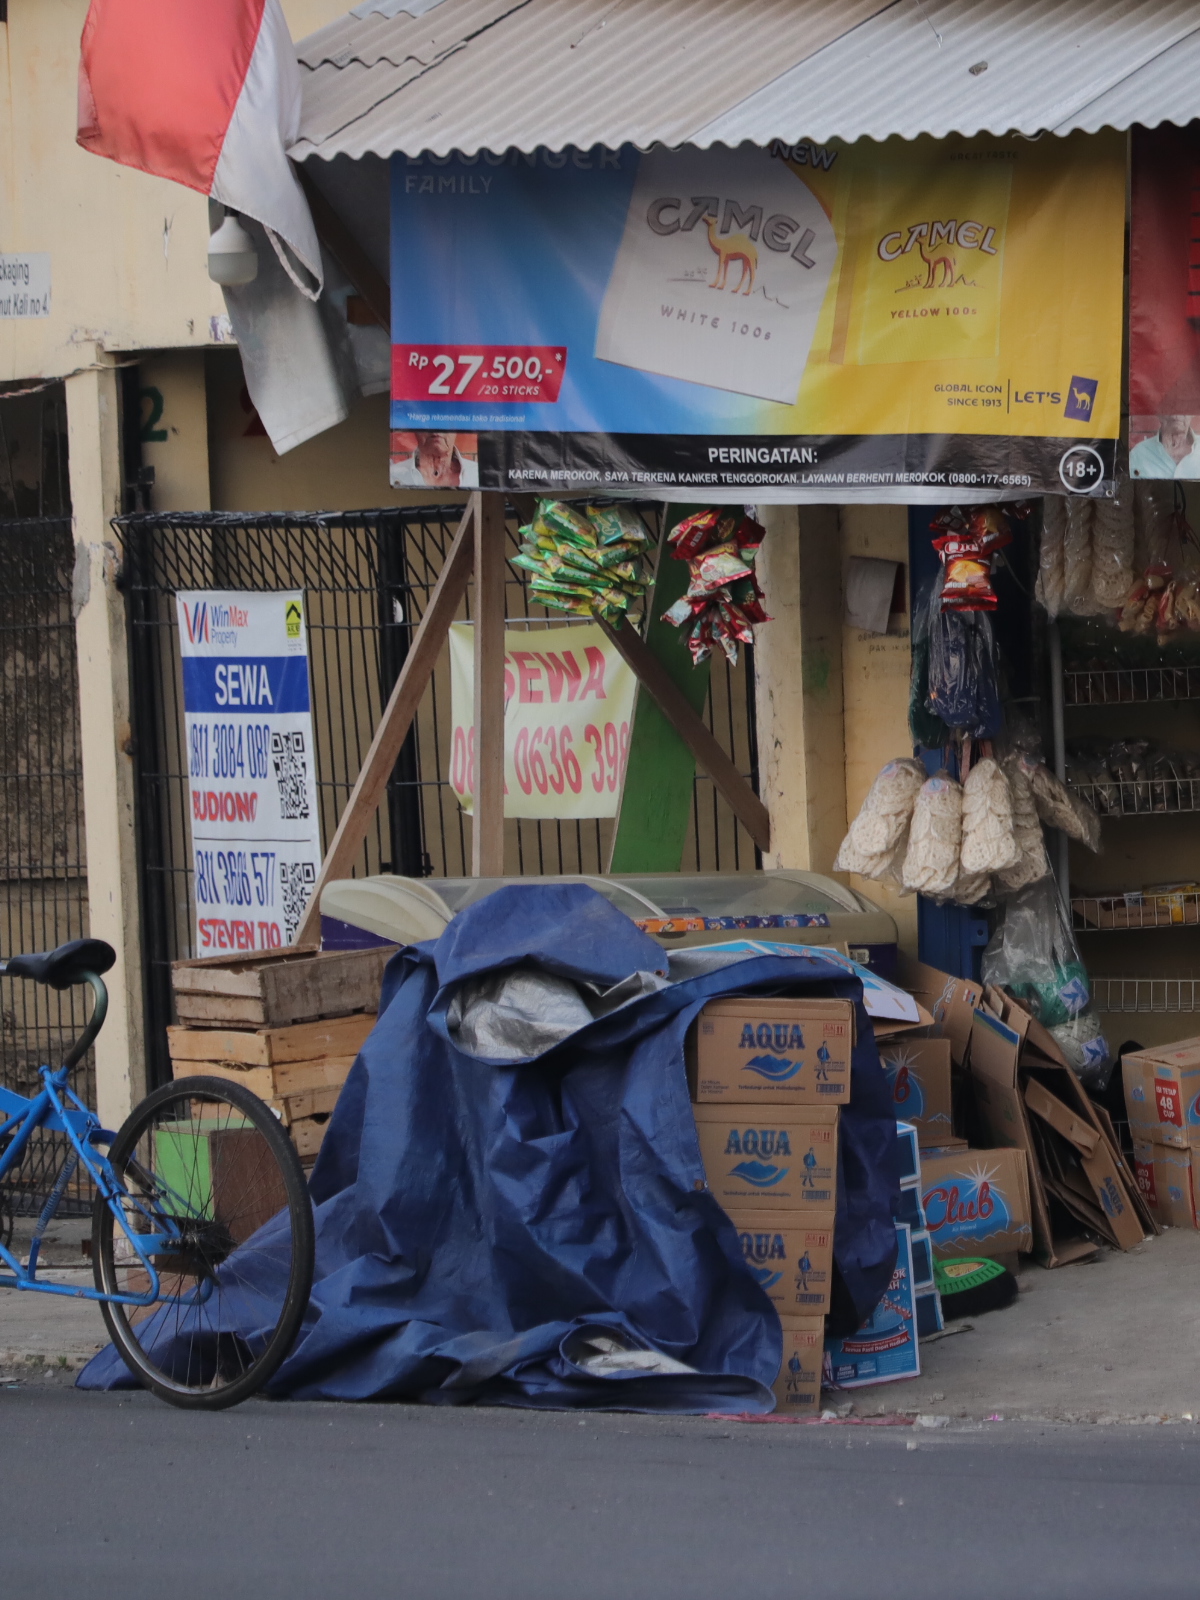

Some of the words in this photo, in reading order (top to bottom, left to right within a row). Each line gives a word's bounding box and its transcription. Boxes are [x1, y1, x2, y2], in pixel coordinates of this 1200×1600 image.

[771, 138, 838, 171] NEW
[405, 175, 493, 194] FAMILY
[646, 196, 817, 270] CAMEL
[877, 219, 999, 262] CAMEL
[660, 304, 720, 331] WHITE
[731, 320, 772, 341] 100s
[890, 308, 940, 320] YELLOW
[945, 306, 978, 317] 100s
[408, 352, 429, 371] Rp
[501, 385, 540, 397] STICKS
[934, 384, 973, 393] GLOBAL
[975, 385, 1003, 393] ICON
[1014, 391, 1062, 404] LET'S
[947, 398, 978, 407] SINCE
[980, 398, 1002, 408] 1913
[472, 414, 488, 422] toko
[489, 413, 526, 423] tradisional
[708, 447, 818, 463] PERINGATAN:
[509, 469, 548, 480] KARENA
[550, 470, 602, 482] MEROKOK,
[604, 471, 629, 482] SAYA
[631, 471, 676, 483] TERKENA
[678, 473, 718, 483] KANKER
[720, 473, 799, 484] TENGGOROKAN.
[801, 473, 845, 484] LAYANAN
[847, 473, 893, 484] BERHENTI
[895, 473, 946, 483] MEROKOK
[948, 473, 1031, 486] (0800-177-6565)
[1065, 462, 1097, 478] 18+
[210, 605, 249, 627] WinMax
[211, 628, 238, 649] Property
[215, 665, 273, 706] SEWA
[213, 724, 244, 778] 3084
[514, 725, 582, 795] 0636
[251, 852, 275, 907] 577
[199, 918, 255, 950] STEVEN
[258, 921, 281, 949] TIO
[738, 1022, 806, 1054] AQUA
[1162, 1087, 1177, 1096] TETAP
[1160, 1096, 1173, 1110] 48
[1163, 1110, 1175, 1118] CUP
[724, 1128, 792, 1160] AQUA
[922, 1181, 994, 1233] Club
